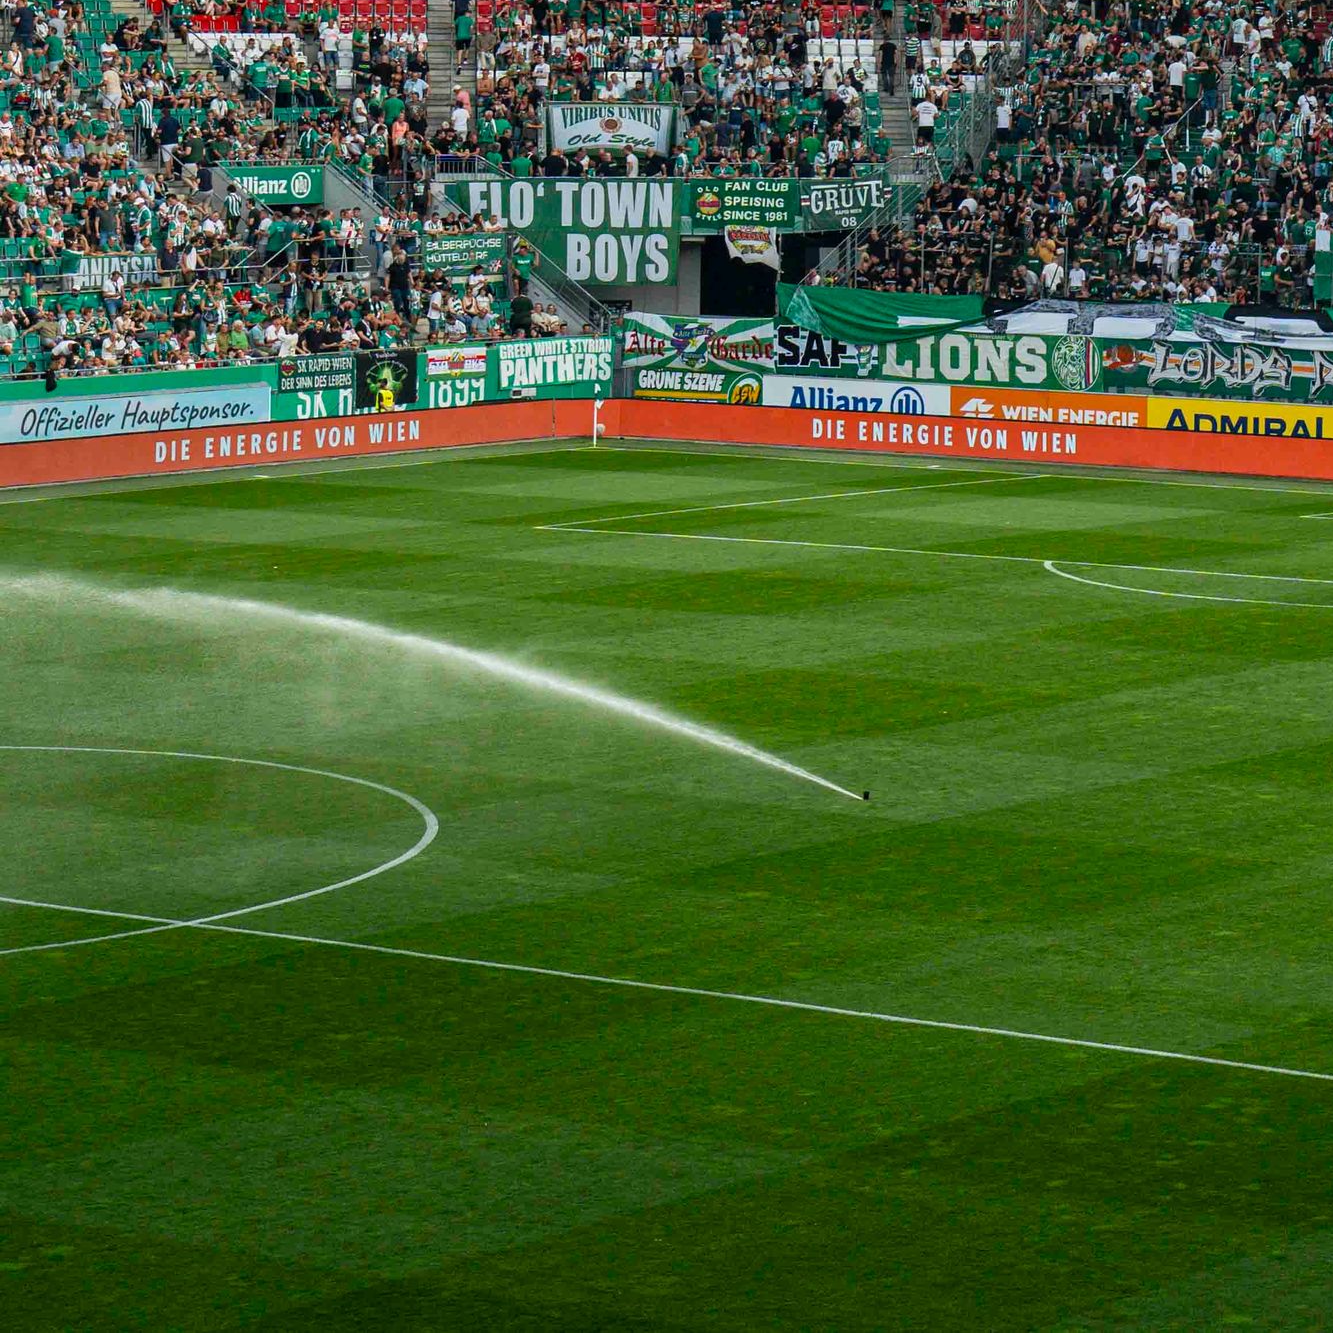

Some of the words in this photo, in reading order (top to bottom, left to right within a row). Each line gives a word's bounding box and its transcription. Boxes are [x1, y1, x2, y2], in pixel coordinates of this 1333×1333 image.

[561, 106, 615, 129] VIRIBUS
[620, 106, 661, 132] UNITIS
[568, 134, 602, 146] Old
[608, 134, 656, 148] Style
[725, 182, 750, 191] FAN
[756, 182, 789, 192] CLUB
[811, 181, 885, 214] GRÜVE
[556, 182, 673, 229] TOWN
[724, 196, 784, 207] SPEISING
[723, 212, 760, 221] SINCE
[764, 212, 788, 222] 1981
[842, 217, 857, 227] 08
[567, 234, 669, 282] BOYS
[500, 343, 532, 359] GREEN
[534, 342, 569, 356] WHITE
[570, 339, 612, 354] STYRIAN
[625, 330, 666, 357] Alte
[708, 336, 775, 361] Garde
[883, 333, 1047, 384] LIONS
[297, 360, 307, 373] SK
[308, 358, 331, 372] RAPID
[332, 357, 352, 370] WIEN
[500, 354, 612, 388] PANTHERS
[1147, 341, 1293, 395] LORDS
[281, 377, 295, 390] DER
[295, 376, 313, 389] SINN
[314, 375, 327, 388] DES
[328, 374, 352, 387] LEBENS
[639, 369, 682, 391] GRÜNE
[683, 372, 725, 392] SZENE
[790, 385, 882, 412] Allianz
[20, 403, 117, 438] Offizieller
[120, 398, 255, 431] Hauptsponsor.
[1002, 404, 1053, 423] WIEN
[1166, 408, 1324, 439] ADMIRAL
[155, 440, 191, 463] DIE
[206, 430, 302, 459] ENERGIE
[314, 425, 356, 449] VON
[368, 419, 420, 443] WIEN
[812, 418, 845, 440] DIE
[859, 420, 953, 447] ENERGIE
[966, 427, 1007, 450] VON
[1021, 431, 1077, 454] WIEN
